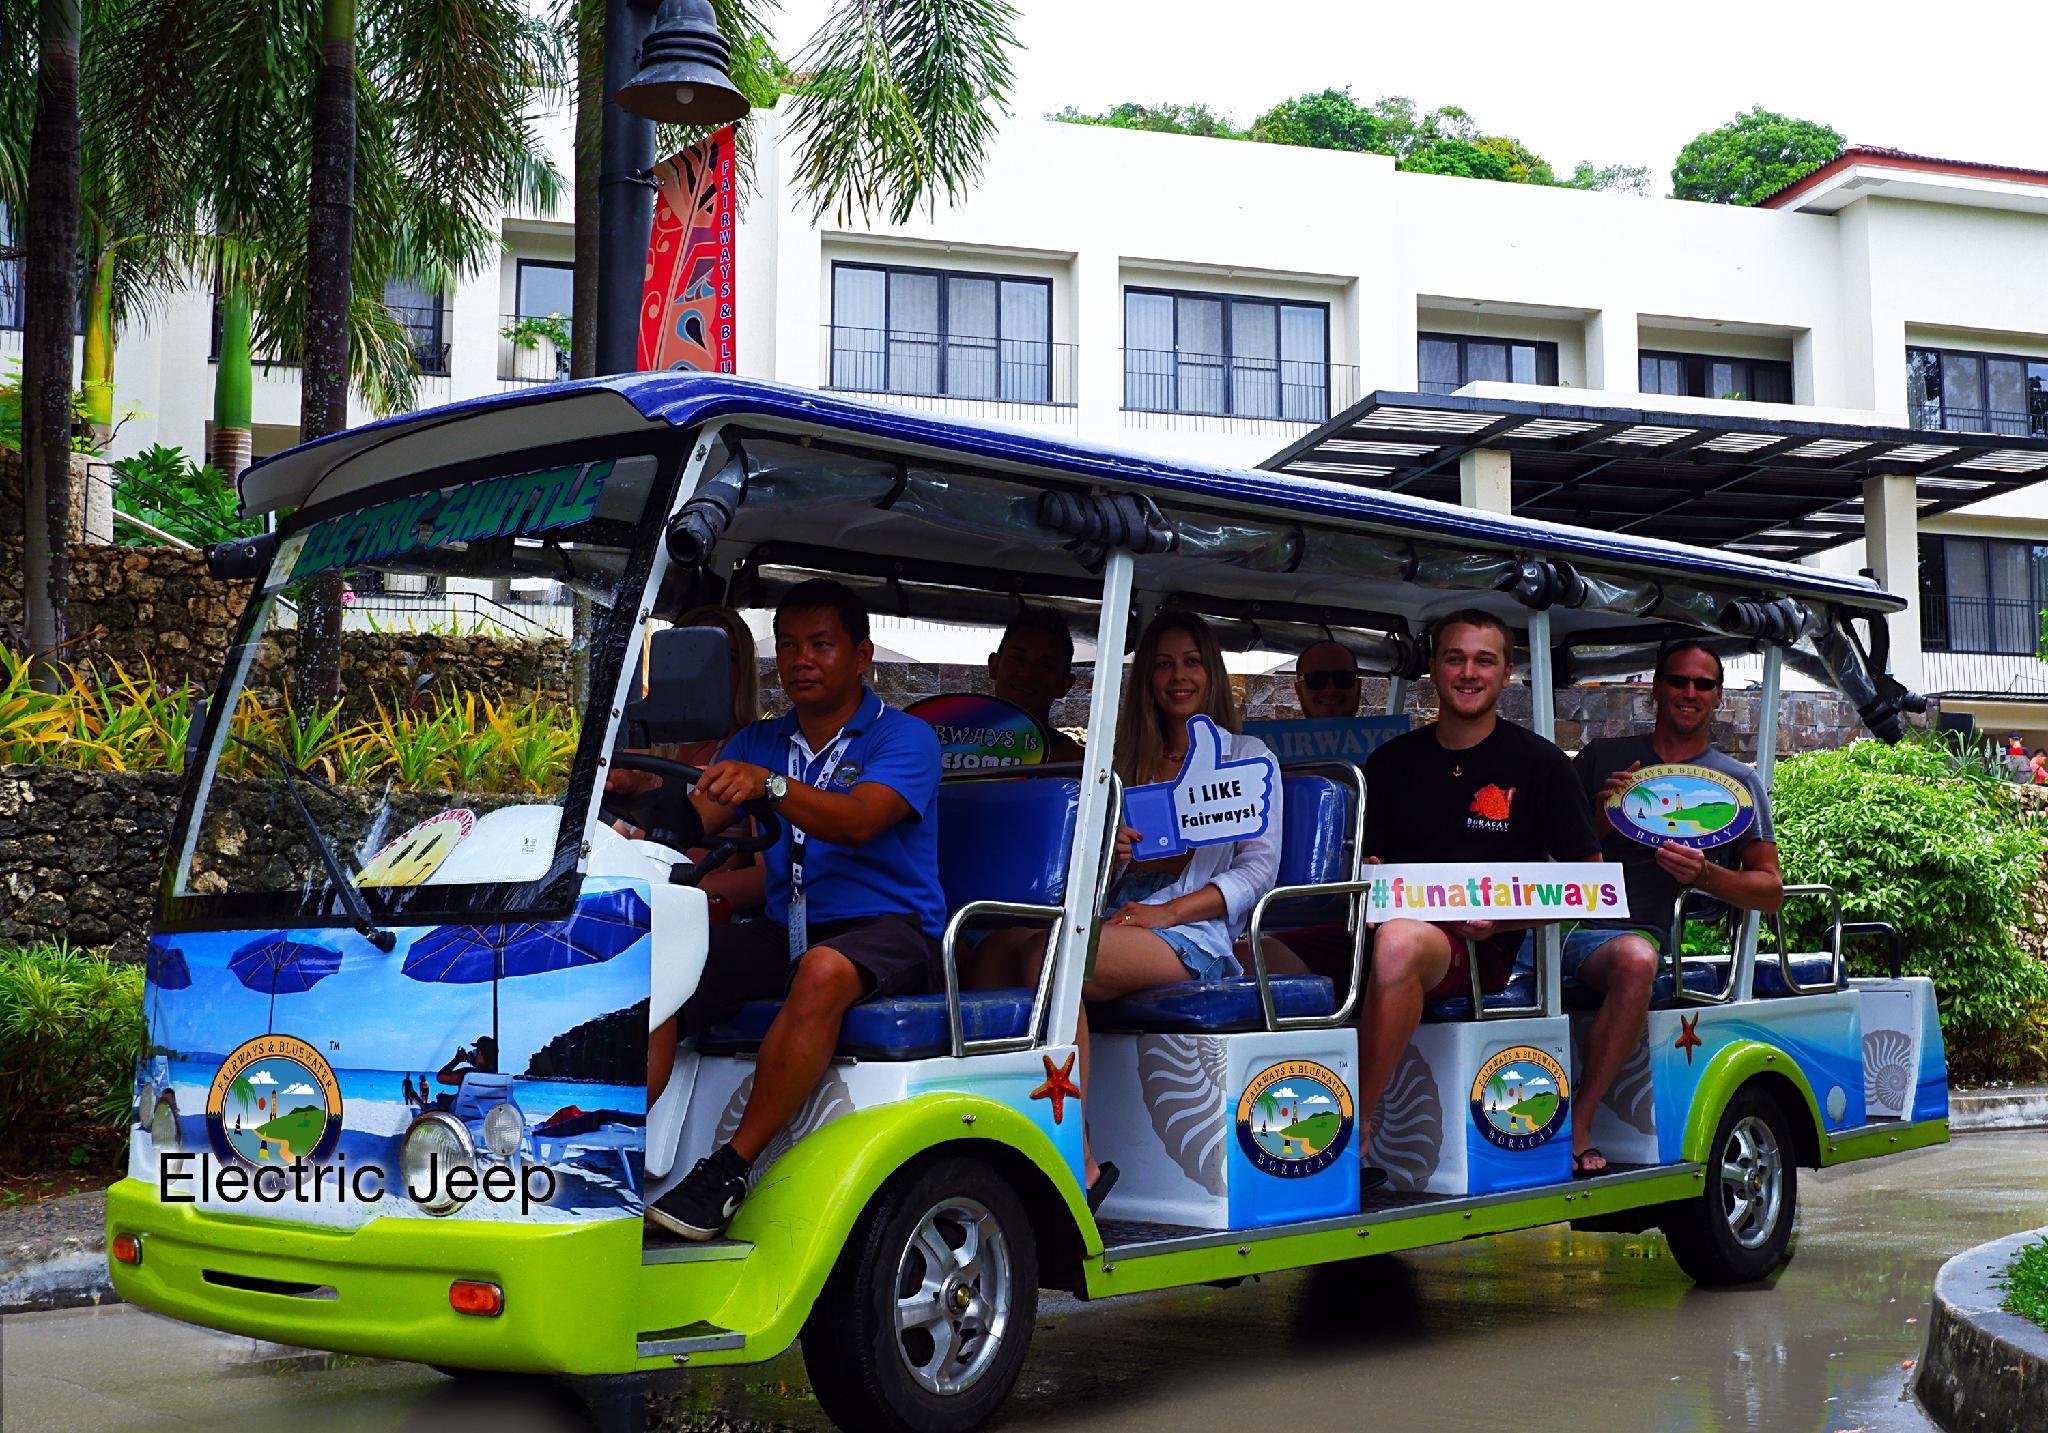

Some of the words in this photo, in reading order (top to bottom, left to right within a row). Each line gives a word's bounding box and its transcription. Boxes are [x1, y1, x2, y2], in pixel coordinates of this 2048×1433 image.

[719, 160, 731, 297] FAIRWAYS
[720, 304, 731, 318] &
[720, 325, 731, 374] BLU
[286, 489, 443, 585] ELECTRIC
[425, 458, 617, 550] SHUTTLE
[934, 724, 1016, 748] RWAYS
[1201, 780, 1242, 802] LIKE
[1679, 767, 1740, 794] BLUEWATER
[1181, 803, 1256, 829] Fairways!
[1371, 876, 1618, 912] #funatfairways
[217, 1042, 265, 1093] FAIRWAYS
[268, 1040, 276, 1053] &
[279, 1041, 333, 1090] BLUEWATER
[1478, 1052, 1512, 1087] FAIRWAYS
[1523, 1051, 1562, 1081] BLUEWATER
[1245, 1067, 1285, 1106] FAIRWAYS
[1289, 1065, 1296, 1074] &
[1298, 1065, 1345, 1099] BLUEWATER
[1488, 1124, 1553, 1149] BORACAY
[1257, 1147, 1334, 1175] BORACAY
